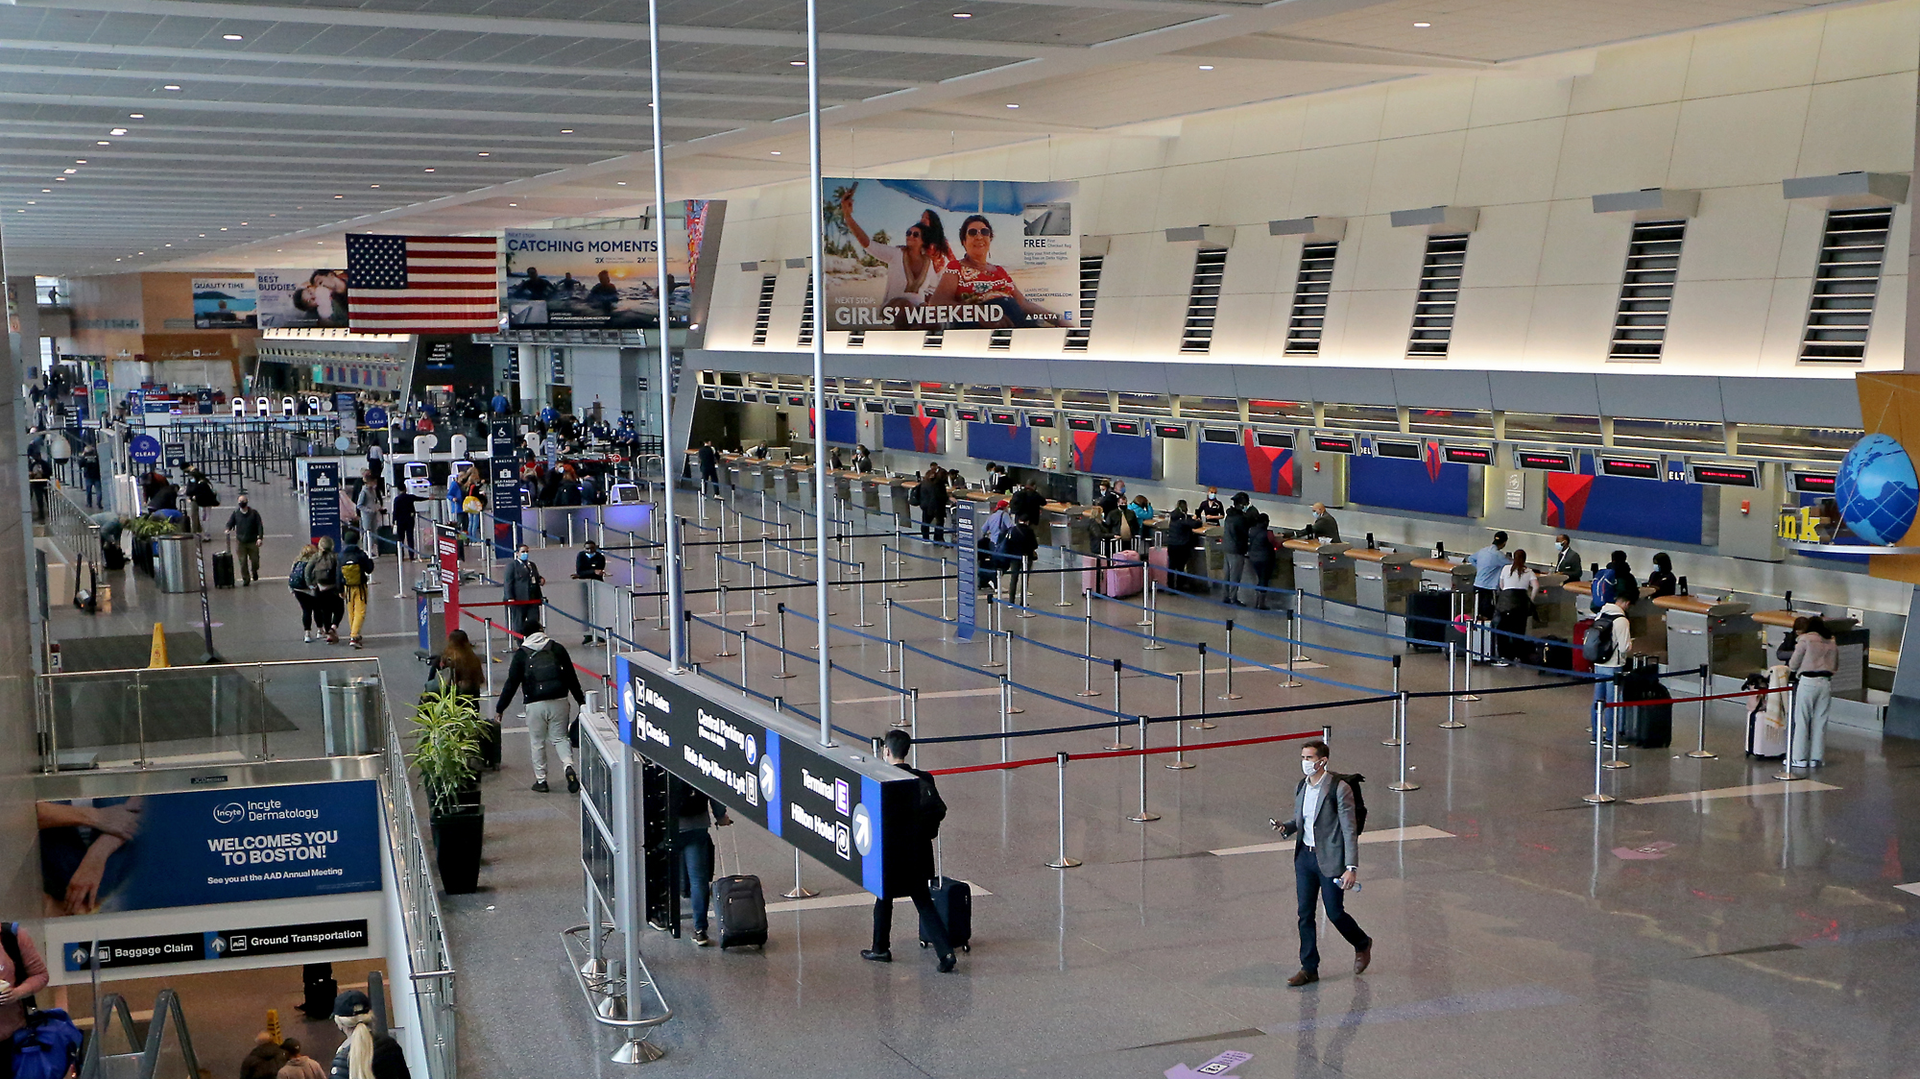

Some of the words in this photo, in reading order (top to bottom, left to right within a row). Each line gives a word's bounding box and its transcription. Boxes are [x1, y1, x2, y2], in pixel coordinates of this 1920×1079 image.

[508, 239, 584, 252] CATCHING
[588, 240, 658, 253] MOMENTS
[1024, 239, 1046, 248] FREE
[835, 307, 900, 325] GIRLS’
[904, 305, 1004, 324] WEEKEND
[1668, 471, 1685, 481] ELT
[654, 692, 670, 713] Gates
[646, 721, 670, 747] Check-in
[698, 708, 720, 734] Central
[720, 719, 745, 750] Parking
[684, 744, 698, 767] Ride
[727, 769, 733, 786] &
[733, 772, 745, 795] Lyft
[802, 768, 834, 801] Terminal
[838, 782, 847, 812] E
[247, 800, 282, 811] Incyte
[248, 808, 319, 821] Dermatology
[791, 802, 814, 830] Hilton
[814, 814, 835, 843] Hotel
[207, 833, 302, 852] WELCOMES
[303, 830, 338, 845] YOU
[221, 851, 246, 866] TO
[249, 845, 327, 864] BOSTON!
[224, 876, 240, 884] you
[263, 872, 282, 880] AAD
[283, 869, 310, 878] Annual
[311, 867, 342, 876] Meeting
[251, 934, 289, 946] Ground
[291, 930, 362, 944] Transportation
[115, 946, 161, 958] Baggage
[164, 942, 193, 954] Claim
